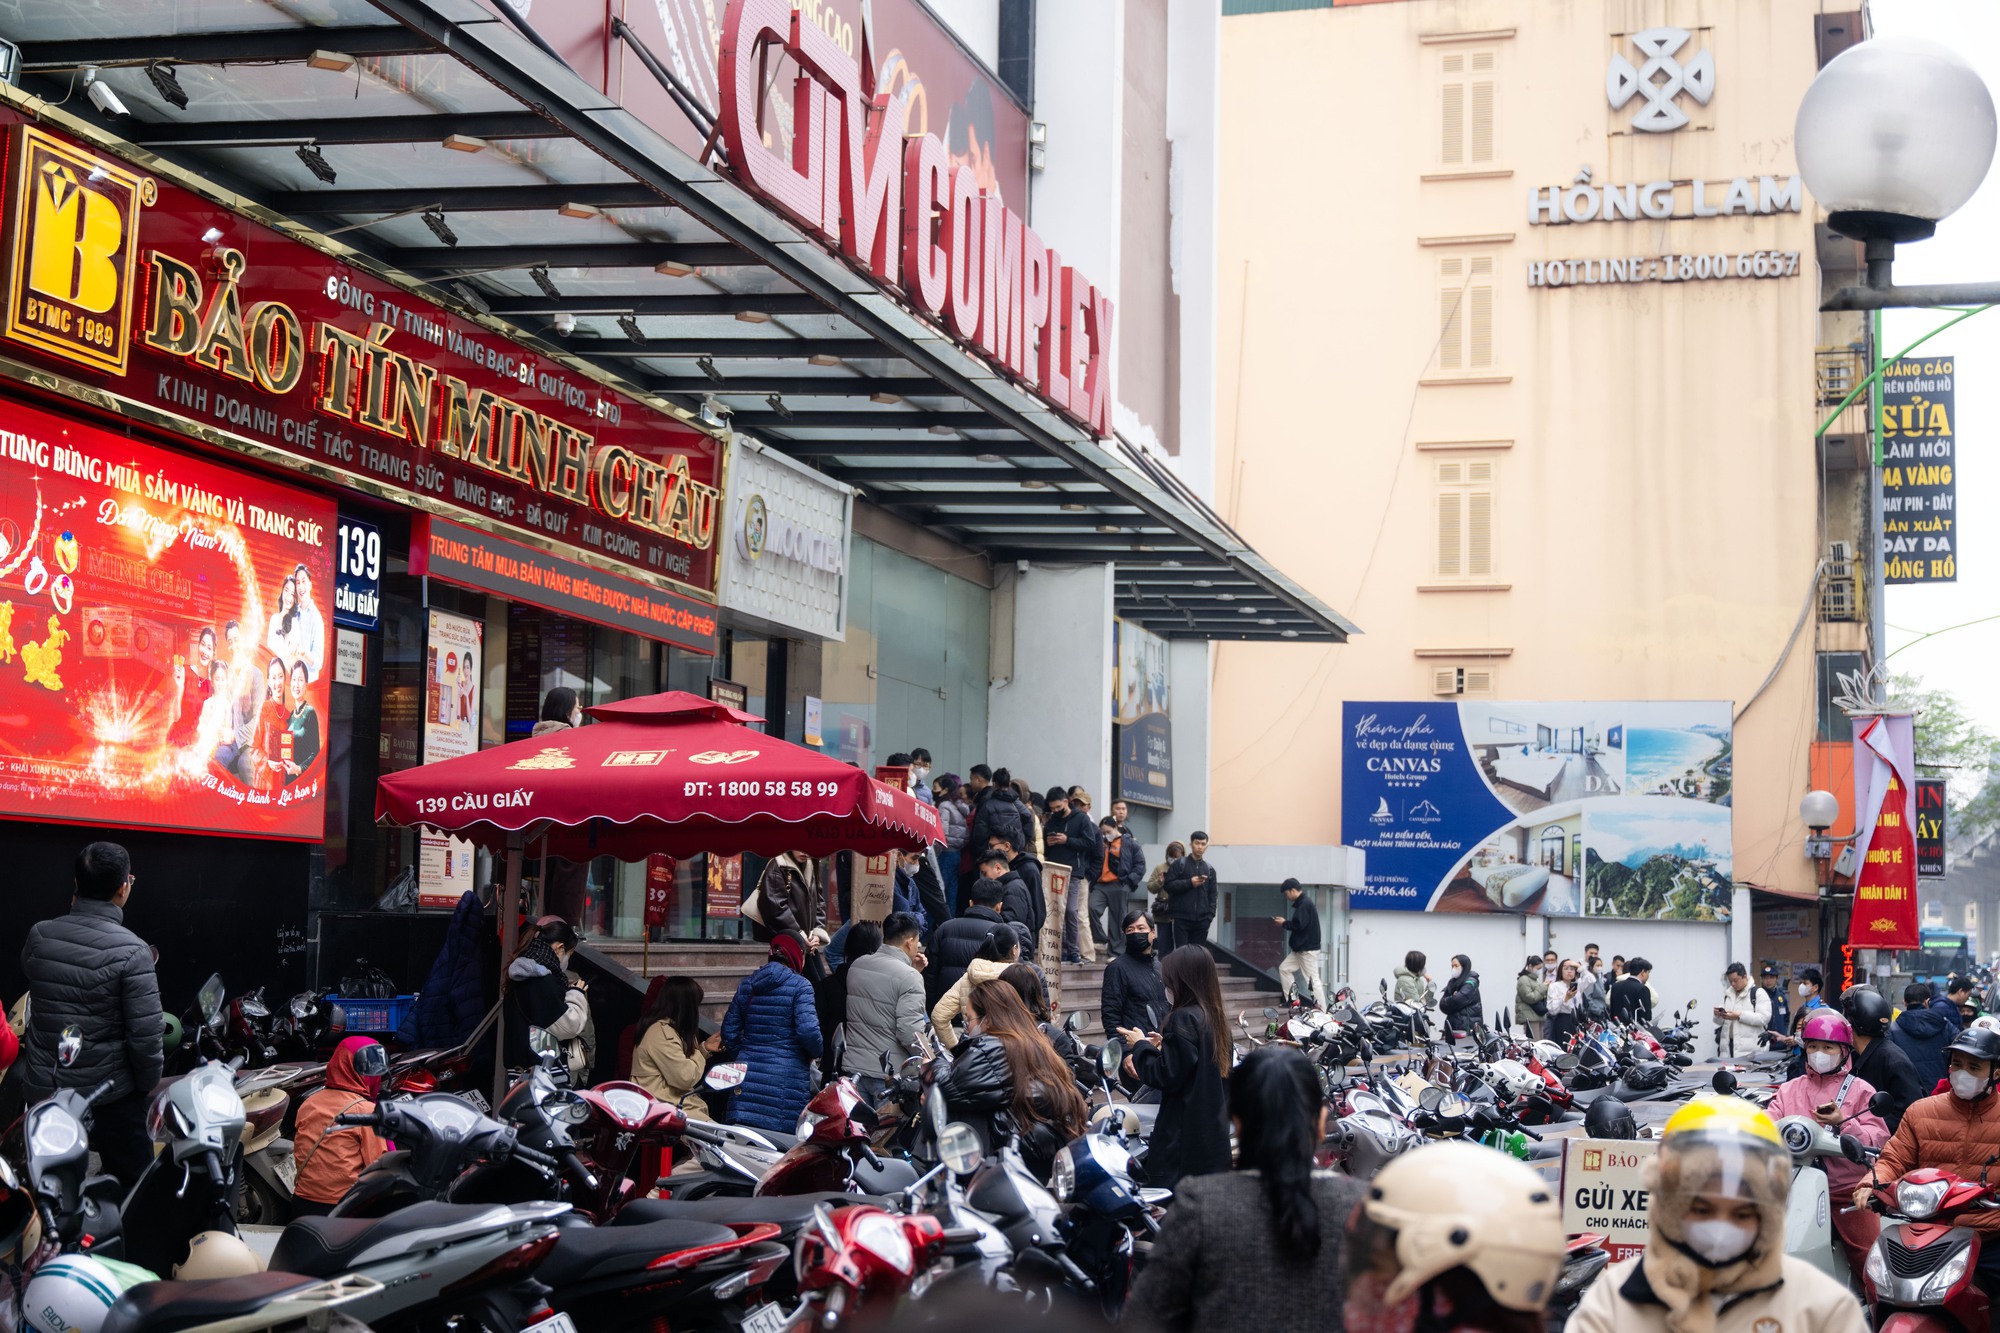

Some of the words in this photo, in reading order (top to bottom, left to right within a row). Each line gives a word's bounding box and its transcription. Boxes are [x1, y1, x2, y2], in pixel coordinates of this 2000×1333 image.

[1528, 164, 1675, 225] HỒNG
[1692, 174, 1803, 217] LAM
[1736, 250, 1799, 279] 6657
[904, 131, 1114, 440] COMPLEX
[26, 297, 71, 334] BTMC
[76, 316, 114, 348] 1989
[322, 273, 375, 317] CÔNG
[381, 299, 400, 328] TY
[404, 310, 444, 347] TNHH
[447, 327, 484, 365] VÀNG
[1883, 360, 1922, 378] UẢNG
[1924, 358, 1952, 376] CÁO
[1884, 380, 1904, 394] RÊN
[1936, 375, 1952, 392] HỒ
[143, 247, 305, 394] BẢO
[313, 322, 438, 448] TÍN
[434, 374, 596, 507] MINH
[592, 445, 720, 550] CHÂU
[1882, 395, 1952, 438] SỬA
[1920, 438, 1950, 458] MỚI
[157, 375, 206, 413] KINH
[214, 394, 278, 437] DOANH
[282, 418, 317, 450] CHẾ
[323, 429, 354, 462] TÁC
[359, 444, 410, 482] TRANG
[415, 463, 445, 493] SỨC
[453, 476, 486, 509] VÀNG
[490, 490, 515, 519] BẠC
[525, 505, 542, 525] ĐÁ
[545, 512, 569, 535] QUÝ
[583, 524, 602, 546] KIM
[603, 531, 641, 560] CƯƠNG
[648, 545, 664, 567] MỸ
[665, 552, 691, 581] NGHỆ
[1906, 462, 1953, 486] VÀNG
[0, 429, 49, 468] TƯNG
[53, 444, 102, 483] BỪNG
[104, 461, 142, 495] MUA
[145, 469, 178, 505] SẮM
[181, 484, 224, 519] VÀNG
[225, 495, 246, 526] VÀ
[248, 506, 295, 539] TRANG
[297, 516, 323, 547] SỨC
[1904, 496, 1924, 511] PIN
[1932, 492, 1953, 511] DÂY
[179, 521, 215, 551] Năm
[1923, 536, 1952, 552] DA
[338, 524, 381, 581] 139
[88, 546, 148, 590] MINH
[430, 534, 469, 565] TRUNG
[471, 545, 494, 573] TÂM
[496, 554, 518, 578] MUA
[520, 560, 542, 585] BÁN
[543, 567, 570, 596] VÀNG
[572, 576, 601, 604] MIẾNG
[602, 588, 630, 616] ĐƯỢC
[630, 597, 650, 618] NHÀ
[650, 602, 676, 627] NƯỚC
[676, 608, 693, 631] CẤP
[694, 614, 716, 637] PHÉP
[335, 584, 356, 613] CẦU
[357, 589, 380, 617] GIẤY
[1355, 714, 1402, 738] Khám
[1400, 714, 1434, 741] phá
[1369, 740, 1388, 750] đẹp
[1404, 740, 1428, 751] dạng
[1430, 741, 1454, 751] cùng
[10, 762, 28, 773] KHAI
[30, 764, 50, 776] XUÂN
[1366, 758, 1441, 772] CANVAS
[684, 782, 712, 797] ĐT:
[718, 781, 760, 796] 1800
[764, 782, 786, 796] 58
[790, 782, 812, 796] 58
[816, 782, 838, 796] 99
[1406, 774, 1427, 782] Group
[416, 797, 448, 815] 139
[451, 791, 489, 811] CẦU
[494, 788, 534, 809] GIẤY
[1884, 811, 1900, 827] MÃI
[1916, 812, 1942, 840] ÂY
[1354, 838, 1370, 848] MỘT
[1372, 840, 1394, 848] HÀNH
[1394, 840, 1416, 848] TRÌNH
[1416, 839, 1440, 849] HOÀN
[1394, 830, 1414, 840] ĐIỂM
[1866, 847, 1890, 866] THUỘC
[1860, 884, 1882, 900] NHÂN
[1884, 884, 1902, 900] DÂN
[1589, 897, 1618, 914] PA
[1608, 1151, 1638, 1168] BẢO
[1575, 1180, 1614, 1210] GỬI
[1620, 1188, 1650, 1212] XE
[1586, 1216, 1609, 1228] CHO
[1612, 1216, 1649, 1229] KHÁCH
[42, 1305, 72, 1332] BIDV
